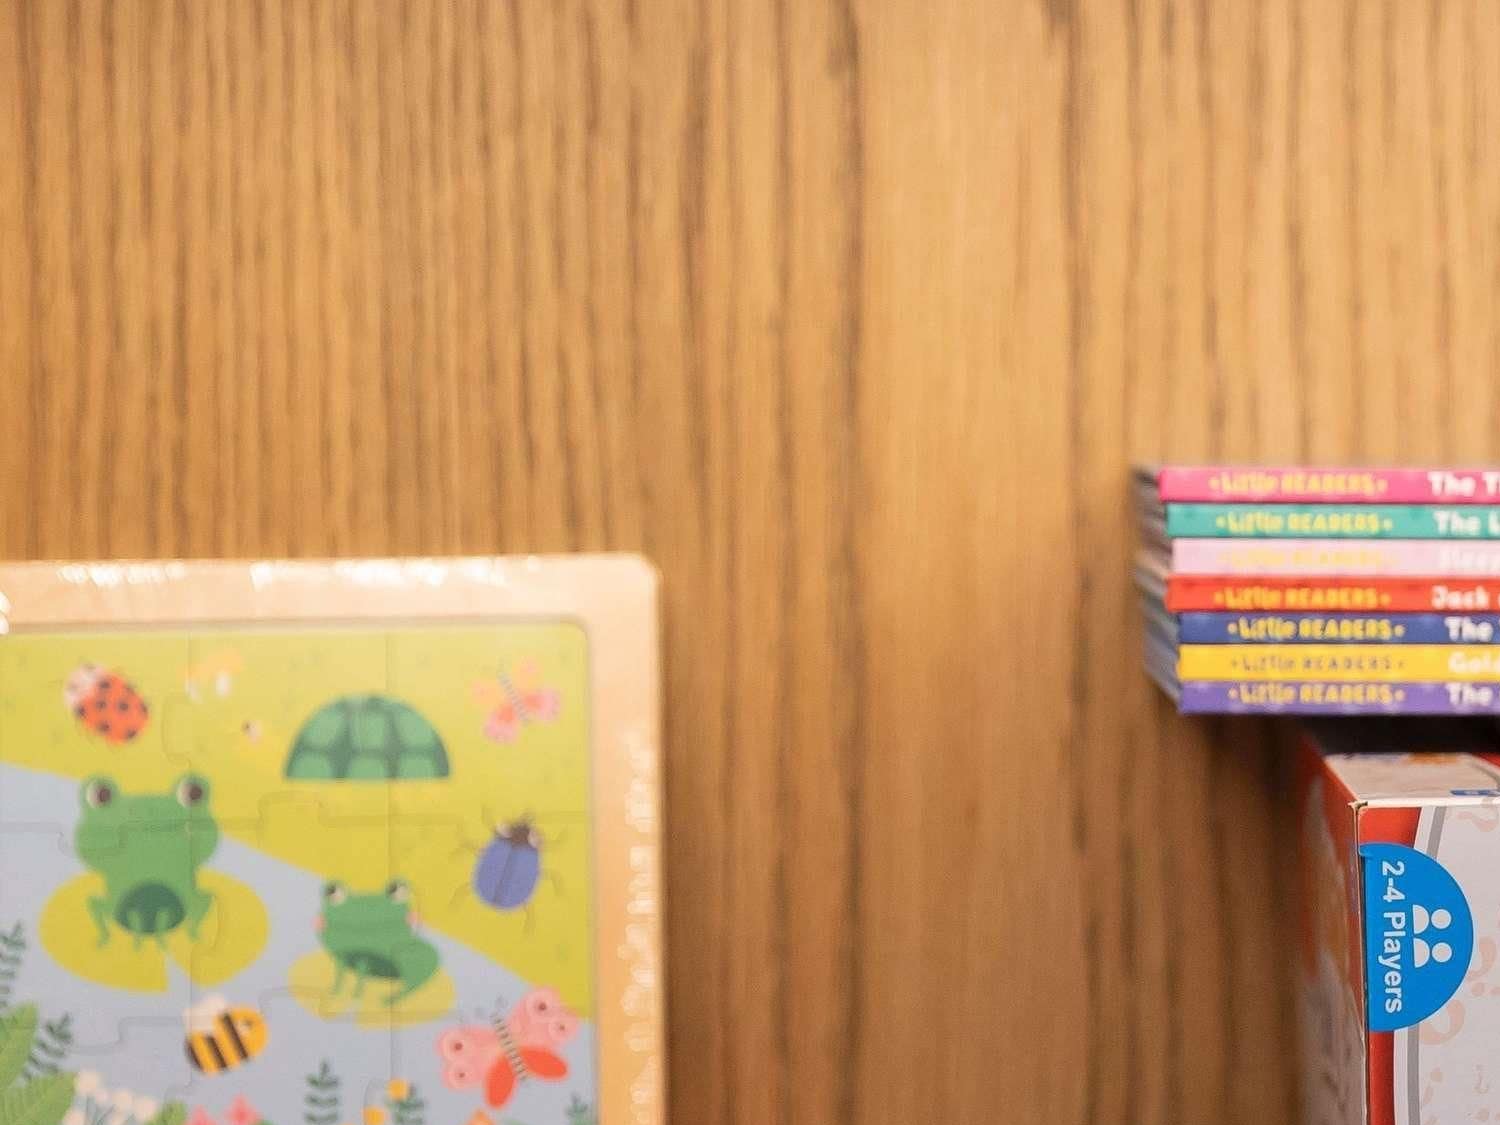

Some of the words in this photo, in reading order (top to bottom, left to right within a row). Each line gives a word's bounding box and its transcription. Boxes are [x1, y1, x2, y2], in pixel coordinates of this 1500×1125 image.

[1428, 471, 1476, 497] The
[1434, 511, 1481, 536] The
[1431, 585, 1490, 610] Jack
[1444, 616, 1493, 642] The
[1446, 682, 1494, 707] The
[1380, 859, 1406, 903] 2-4
[1383, 910, 1406, 1014] Players
